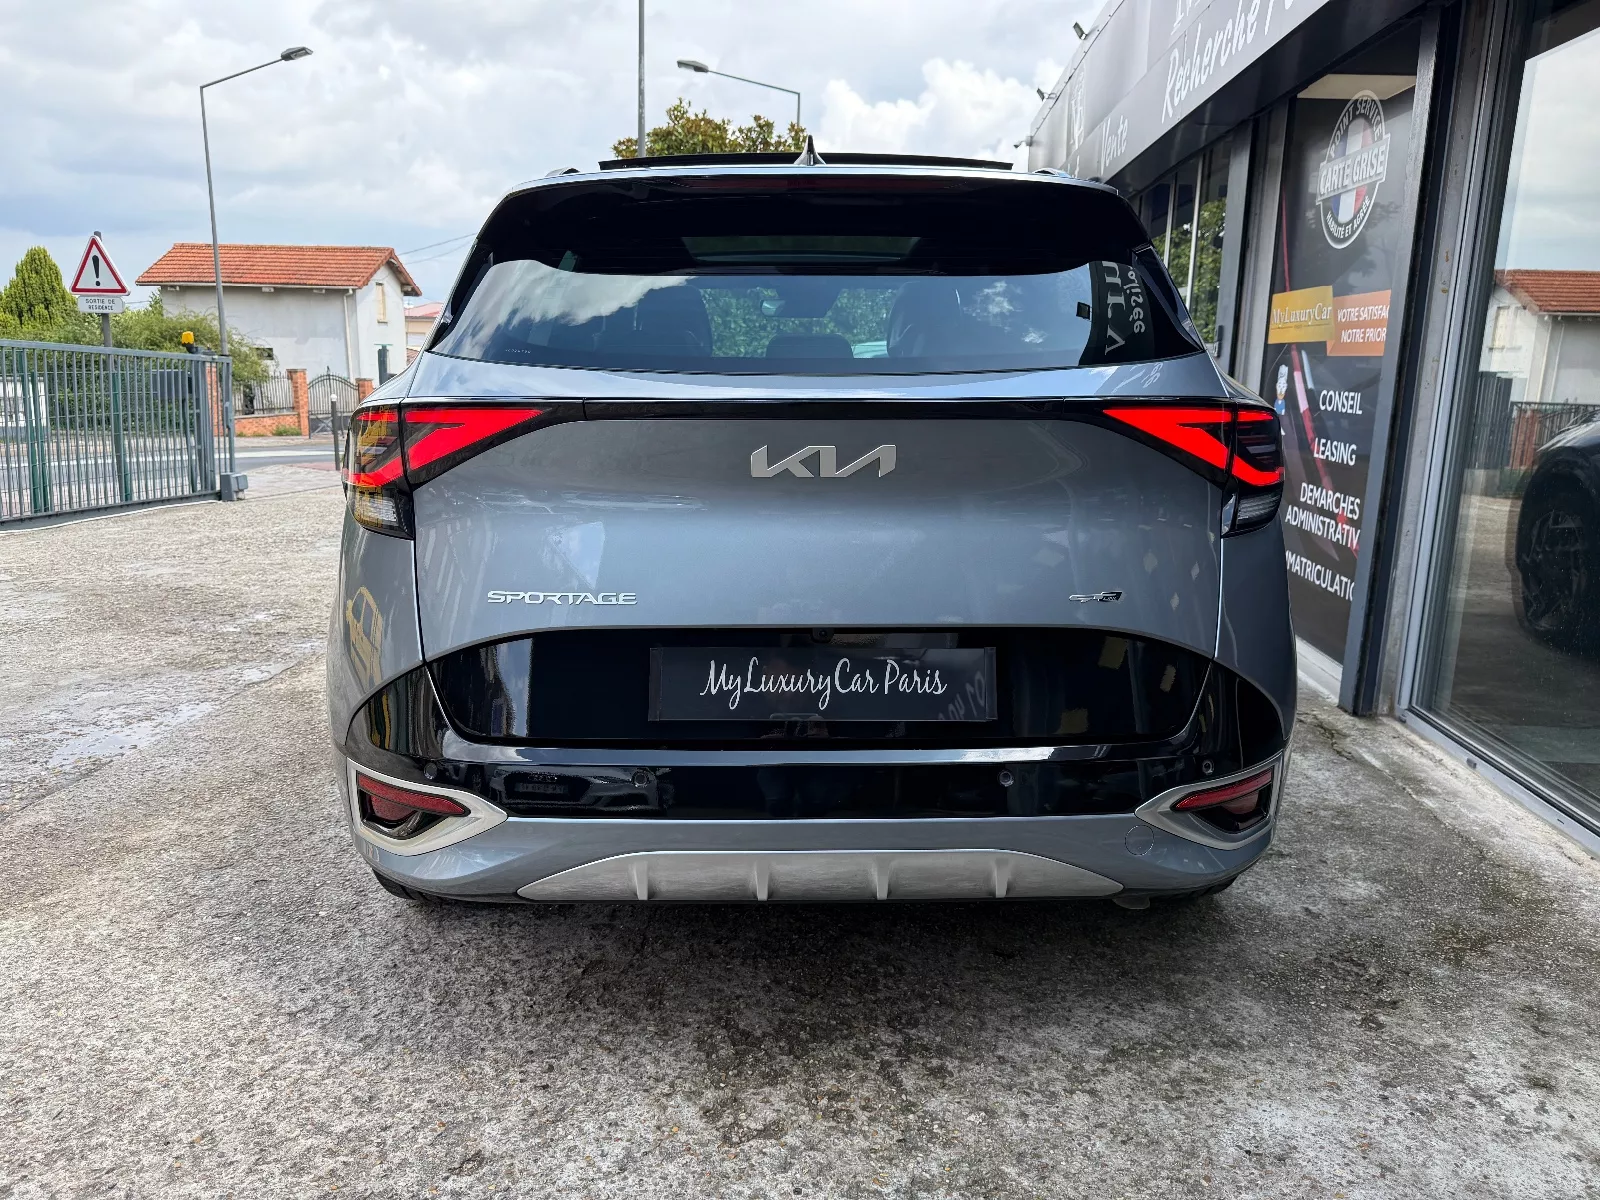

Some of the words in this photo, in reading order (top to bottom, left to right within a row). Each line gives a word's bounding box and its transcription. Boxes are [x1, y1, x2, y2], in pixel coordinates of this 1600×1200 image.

[1330, 104, 1355, 159] POINT
[1355, 97, 1383, 142] SERVICE
[1101, 115, 1128, 176] Vente
[1319, 161, 1351, 195] CARTE
[1353, 144, 1387, 182] GRISE
[1344, 223, 1352, 238] ET
[1273, 302, 1333, 326] MyLuxuryCar
[1337, 307, 1359, 323] VOTRE
[1341, 329, 1364, 343] NOTRE
[1319, 389, 1363, 415] CONSEIL
[1313, 437, 1357, 466] LEASING
[1300, 482, 1361, 520] DEMARCHES
[1284, 504, 1361, 550] ADMINISTRATIV
[487, 590, 638, 605] SPORTAGE
[884, 658, 948, 695] Paris
